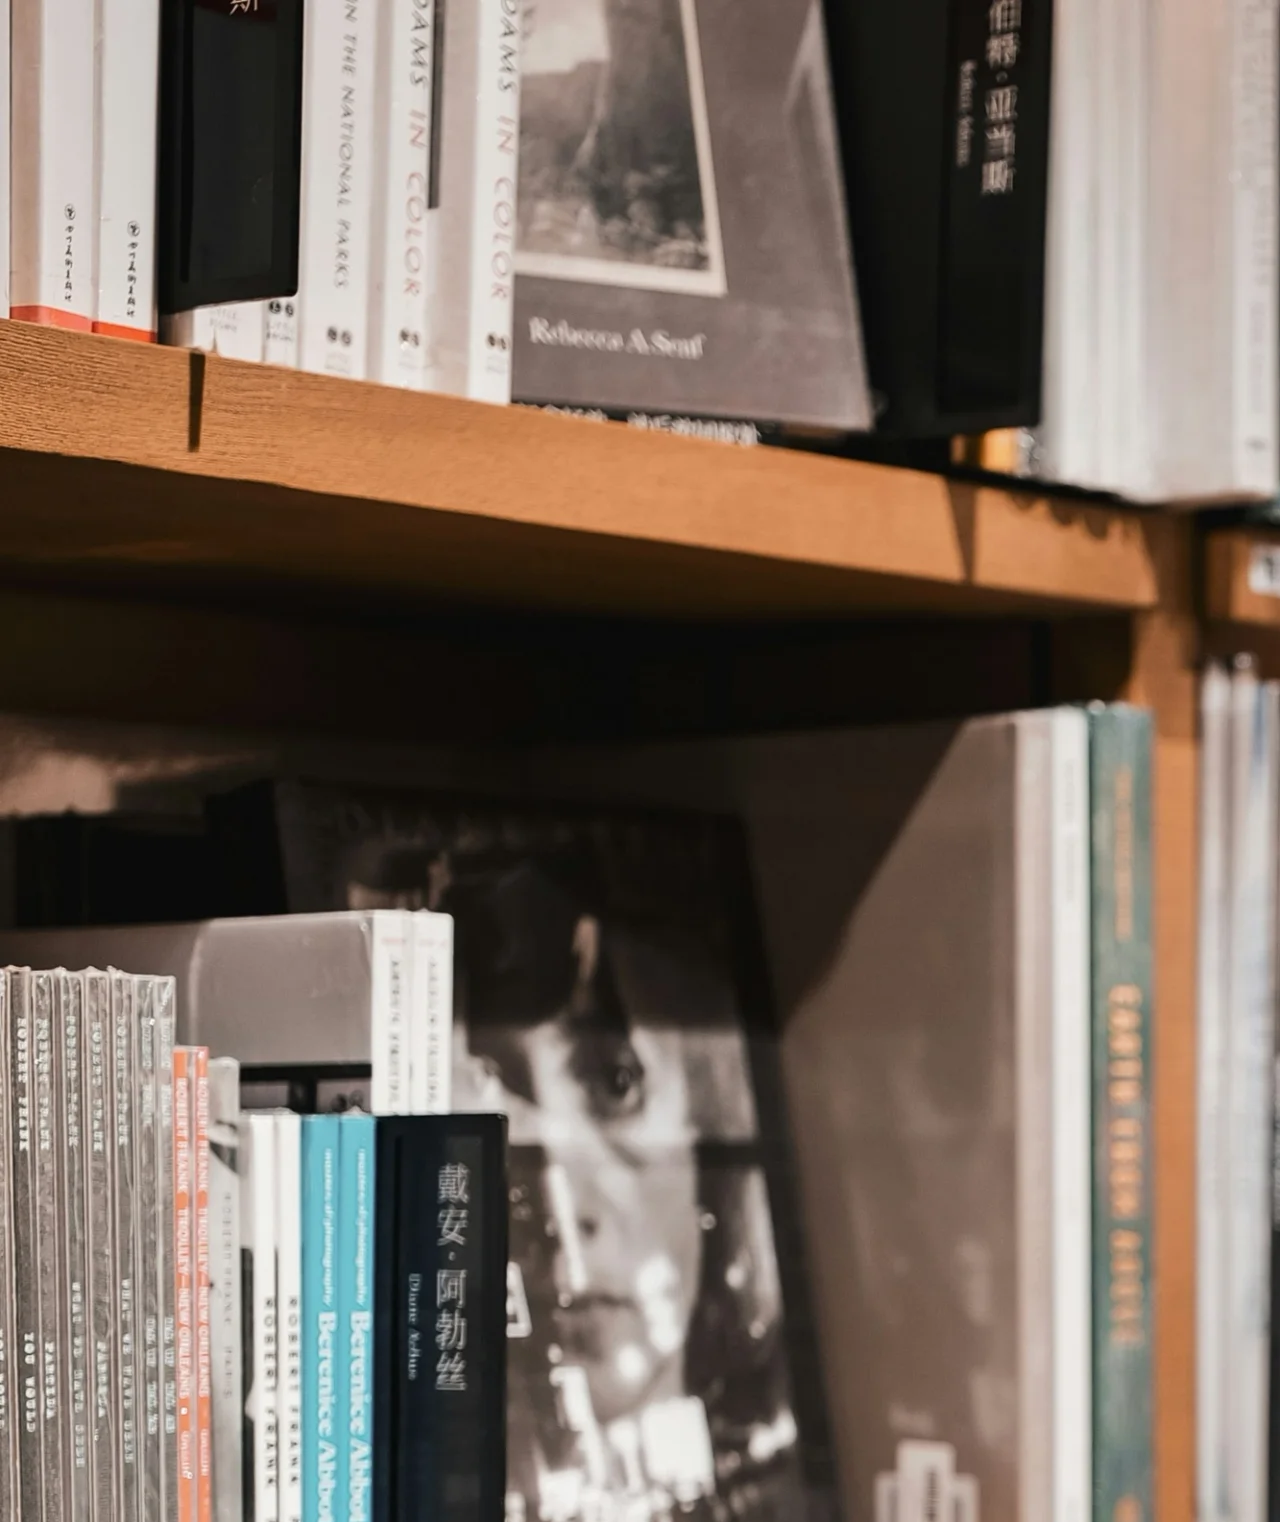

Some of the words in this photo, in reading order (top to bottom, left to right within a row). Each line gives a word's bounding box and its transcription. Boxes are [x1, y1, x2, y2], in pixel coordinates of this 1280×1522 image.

[342, 34, 358, 75] THE
[337, 85, 355, 207] NATIONAL
[408, 109, 427, 150] IN
[496, 115, 515, 156] IN
[333, 218, 351, 289] PARKS
[404, 171, 425, 297] COLOR
[490, 176, 514, 300] COLOR
[528, 316, 624, 352] Rebecca
[17, 1018, 28, 1083] ROBERT
[91, 1021, 102, 1086] ROBERT
[18, 1096, 29, 1151] FRANK
[93, 1099, 104, 1151] FRANK
[176, 1077, 188, 1136] ROBERT
[198, 1077, 208, 1136] ROBERT
[176, 1140, 189, 1192] FRANK
[198, 1140, 208, 1191] FRANK
[223, 1193, 232, 1259] ROBERT
[40, 1097, 49, 1151] FRANK
[45, 1341, 56, 1420] PARTIDA
[72, 1281, 82, 1323] WHAT
[121, 1279, 131, 1322] WHAT
[408, 1273, 421, 1324] Diane
[24, 1332, 35, 1365] YOU
[179, 1326, 191, 1398] ORLEANS
[199, 1326, 209, 1397] ORLEANS
[264, 1298, 276, 1391] ROBERT
[288, 1298, 299, 1391] ROBERT
[350, 1311, 371, 1435] Berenice
[408, 1327, 421, 1381] Arbus
[25, 1376, 36, 1432] WOULD
[74, 1370, 84, 1413] HAVE
[97, 1341, 108, 1419] PARTIDA
[123, 1365, 133, 1409] HAVE
[318, 1312, 337, 1437] Berenice
[265, 1406, 276, 1486] FRANK
[289, 1405, 299, 1486] FRANK
